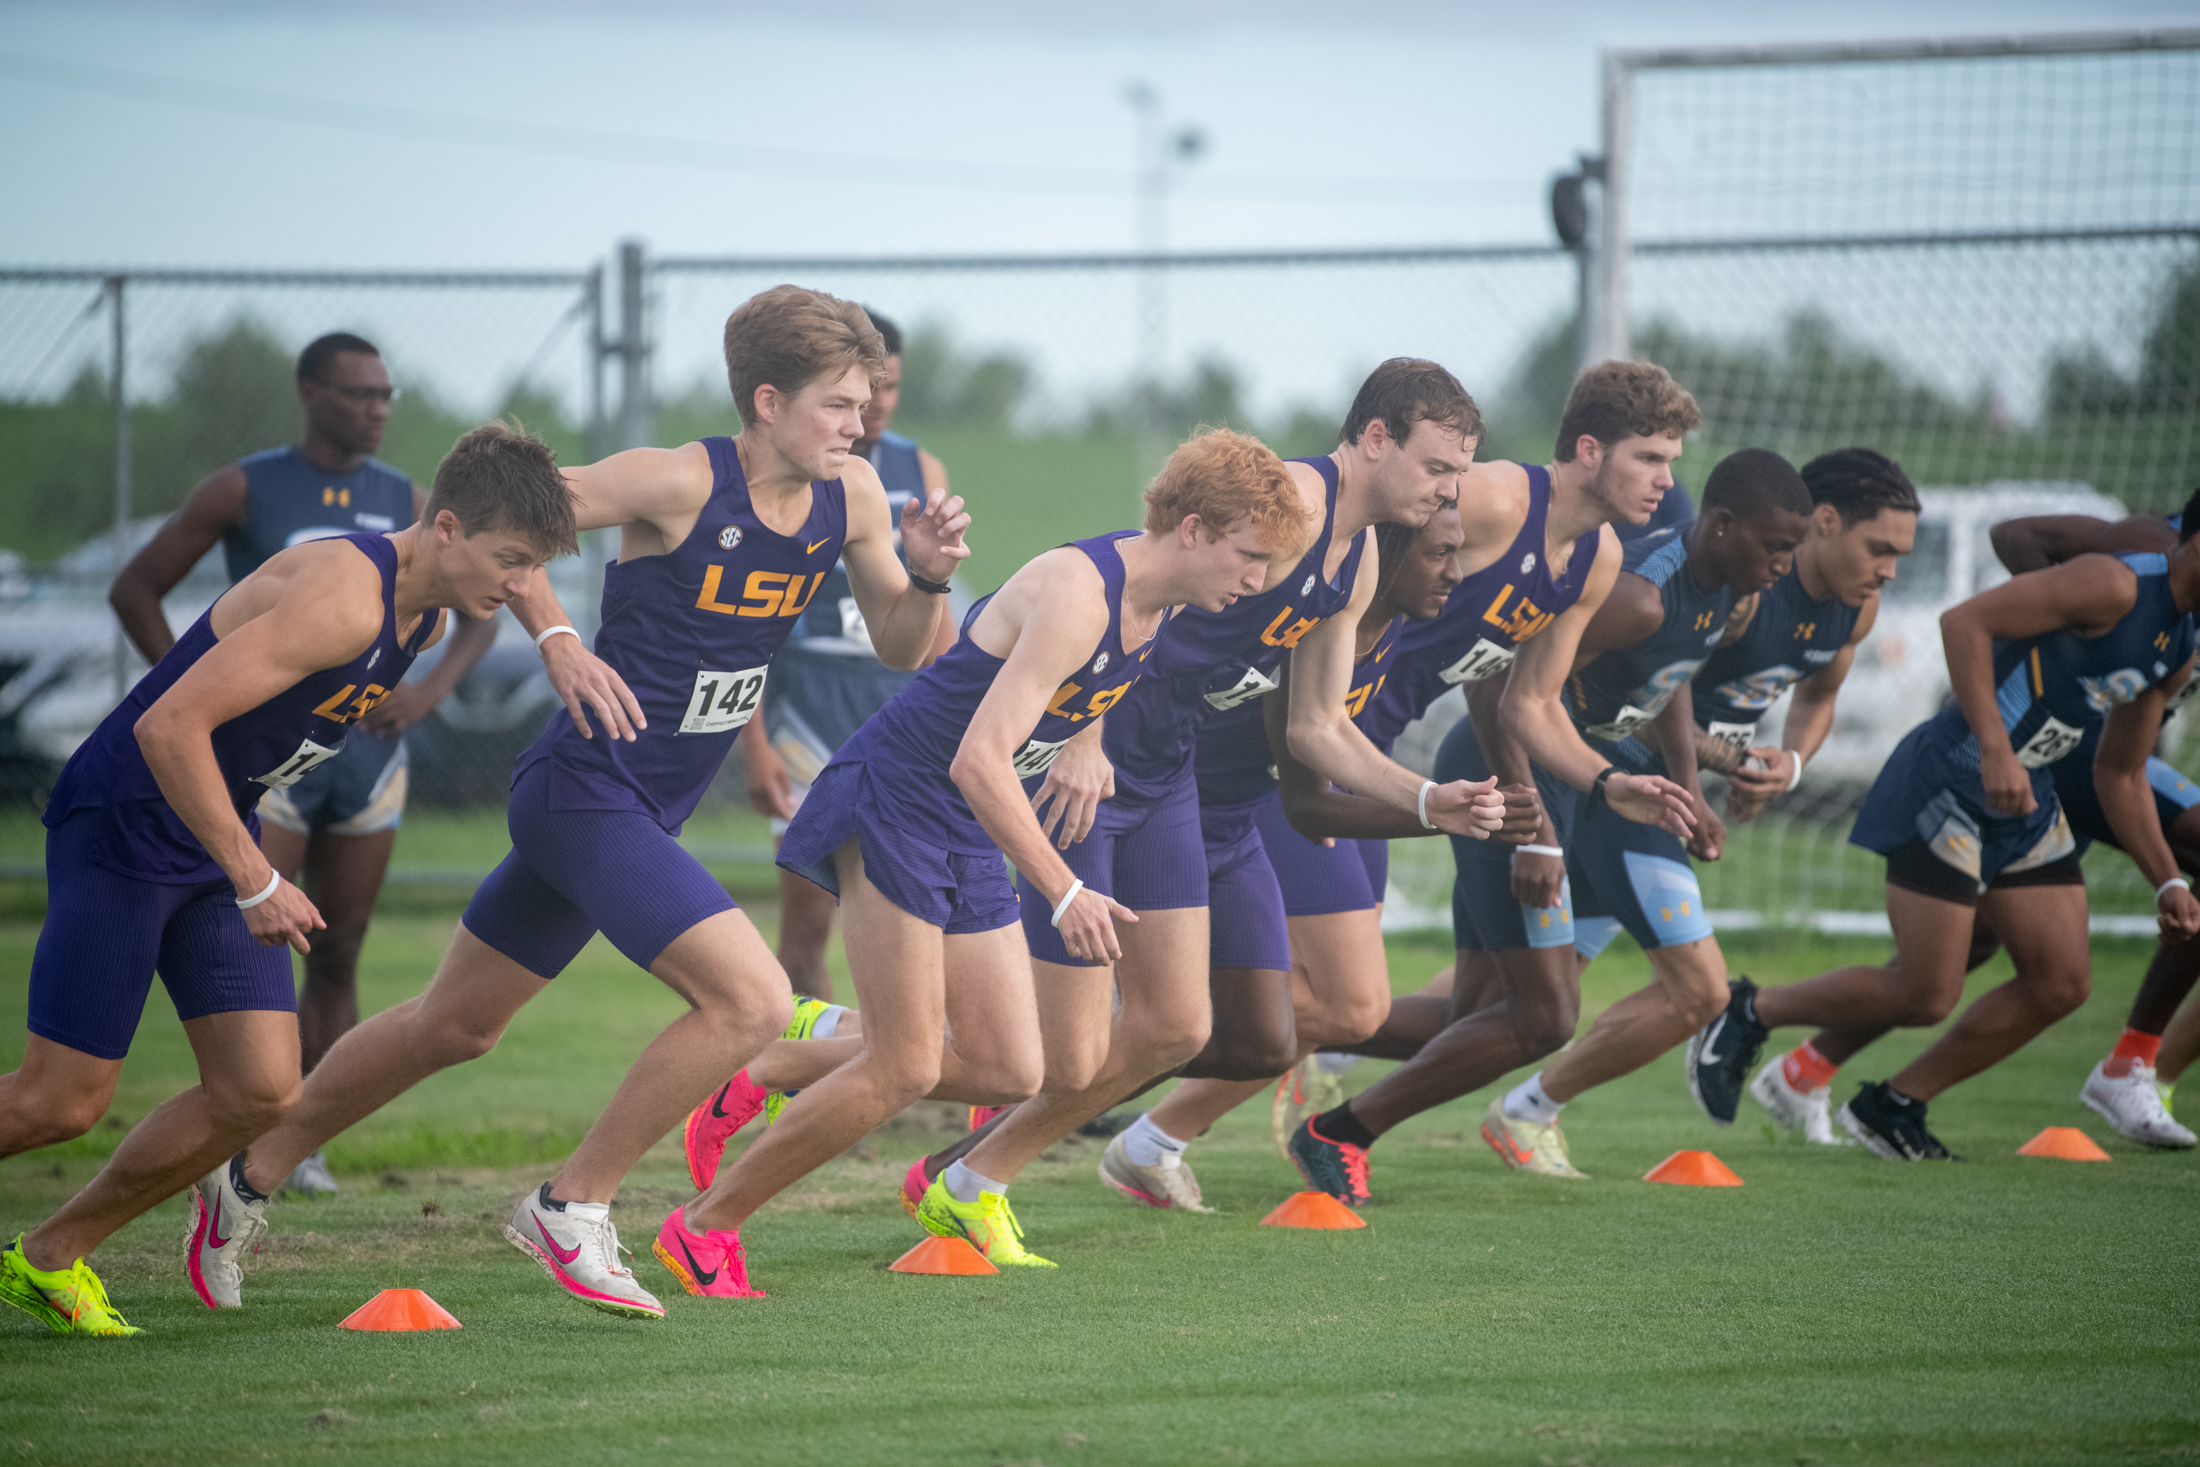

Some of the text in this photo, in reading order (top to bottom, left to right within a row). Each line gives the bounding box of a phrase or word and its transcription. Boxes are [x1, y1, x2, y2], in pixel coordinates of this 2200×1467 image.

[720, 526, 741, 548] SEC
[695, 564, 825, 617] LSU
[1483, 583, 1555, 641] LSU
[698, 675, 763, 716] 142
